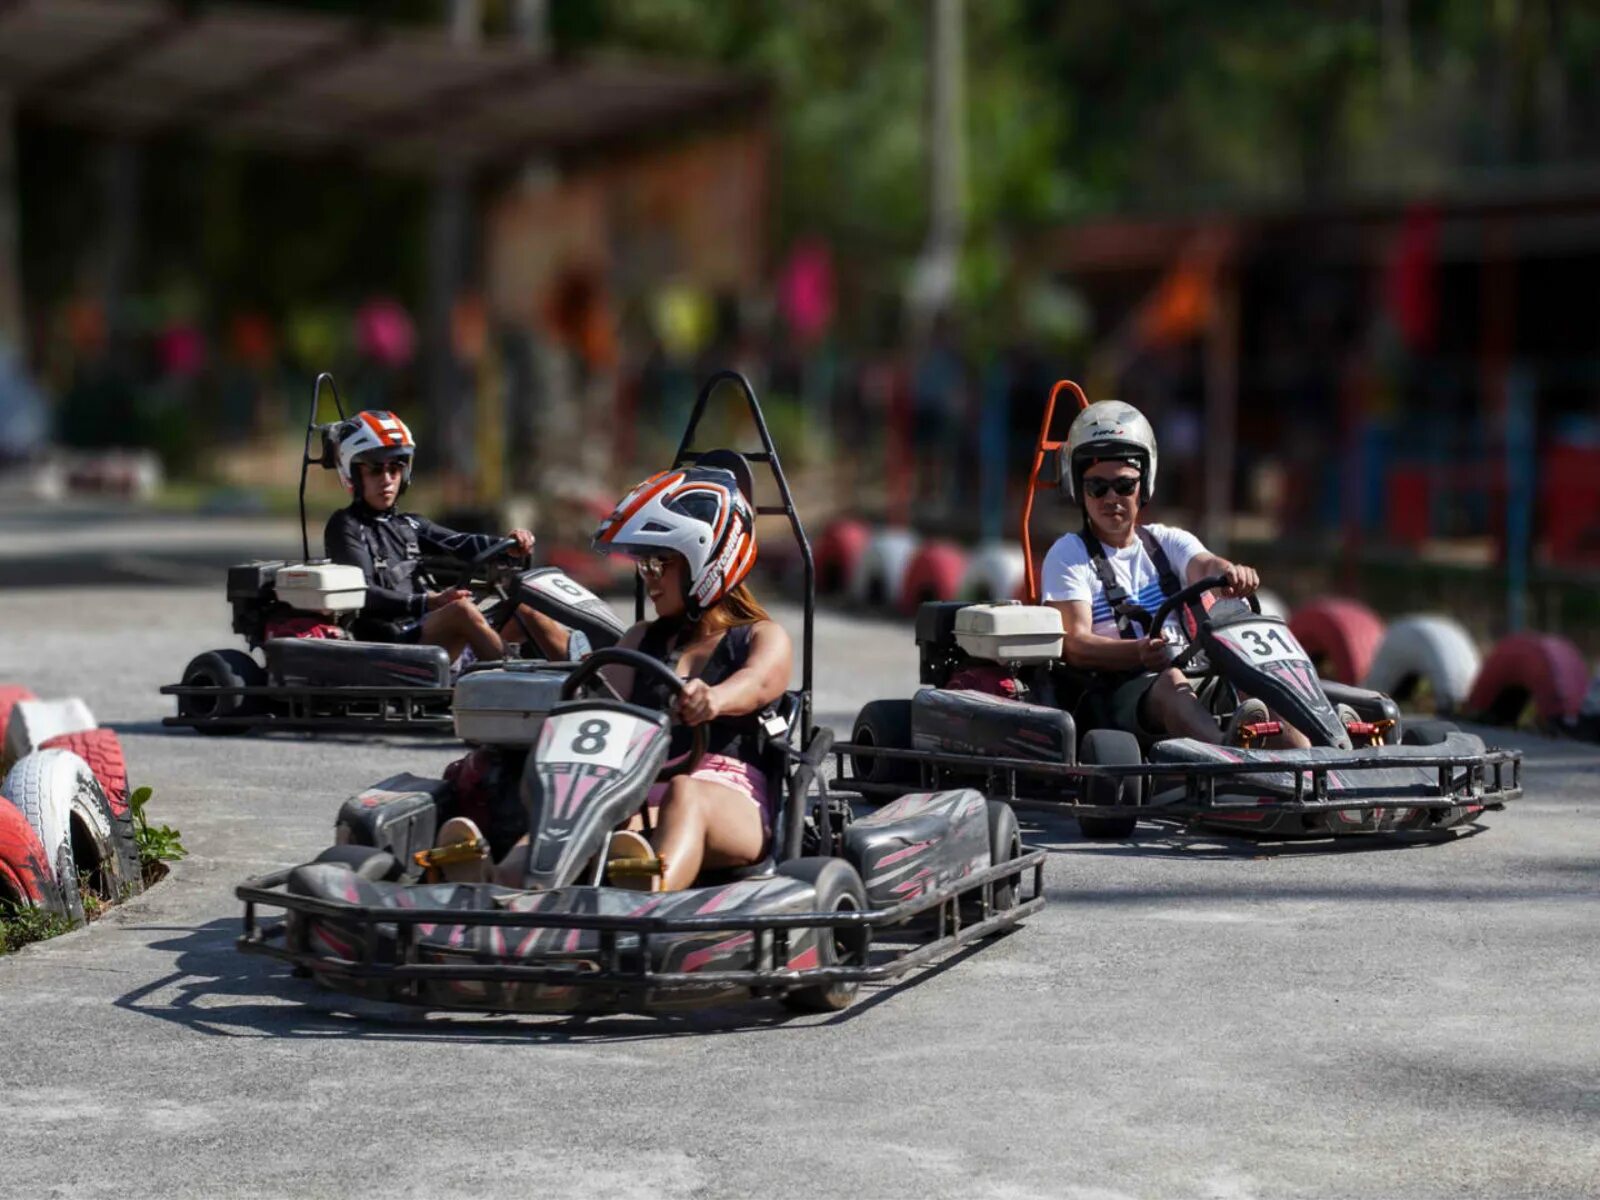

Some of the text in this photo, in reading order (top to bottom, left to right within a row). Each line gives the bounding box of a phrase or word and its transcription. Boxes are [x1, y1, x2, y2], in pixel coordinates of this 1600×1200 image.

[552, 579, 582, 596] 6
[1241, 628, 1293, 656] 31
[571, 718, 611, 755] 8
